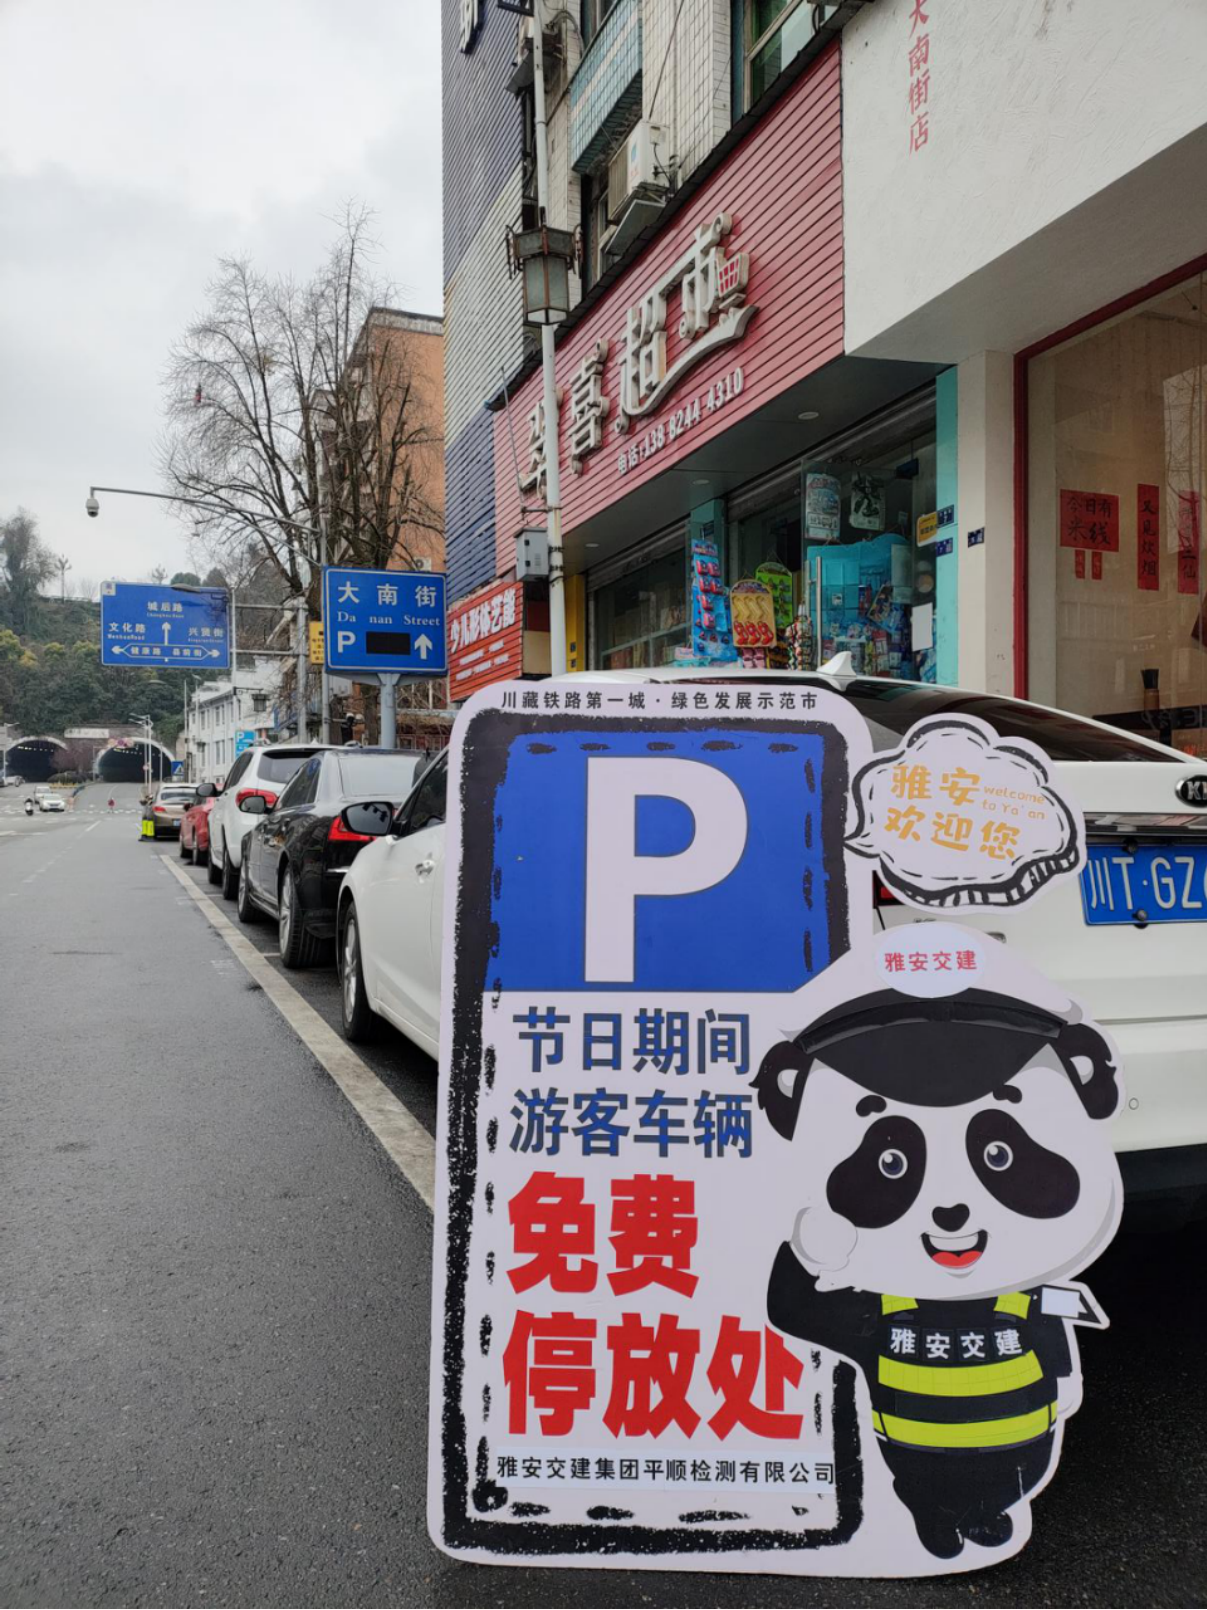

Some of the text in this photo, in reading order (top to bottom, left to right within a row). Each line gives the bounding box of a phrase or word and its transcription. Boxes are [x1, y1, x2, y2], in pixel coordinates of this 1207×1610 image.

[669, 397, 702, 441] 8244
[706, 366, 744, 413] 4310
[1067, 496, 1113, 519] 今日有
[337, 581, 437, 608] 大南街
[108, 622, 146, 633] 文化路
[337, 611, 440, 626] Da nan Street
[337, 631, 356, 653] P
[501, 691, 818, 710] 川藏铁路第一城·绿色发展示范市
[891, 764, 981, 806] 雅安
[984, 786, 1046, 804] welcome
[983, 799, 996, 811] to
[884, 805, 1022, 860] 欢迎您
[585, 757, 748, 982] P
[1088, 857, 1207, 911] 川T·GZ
[884, 949, 977, 973] 雅安交建
[513, 1006, 751, 1076] 节日期间
[509, 1087, 753, 1158] 游客车辆
[506, 1171, 700, 1299] 免费
[890, 1327, 1023, 1359] 雅安交建
[502, 1309, 805, 1441] 停放处
[496, 1456, 835, 1484] 雅安交建集团平顺检测有限公司
